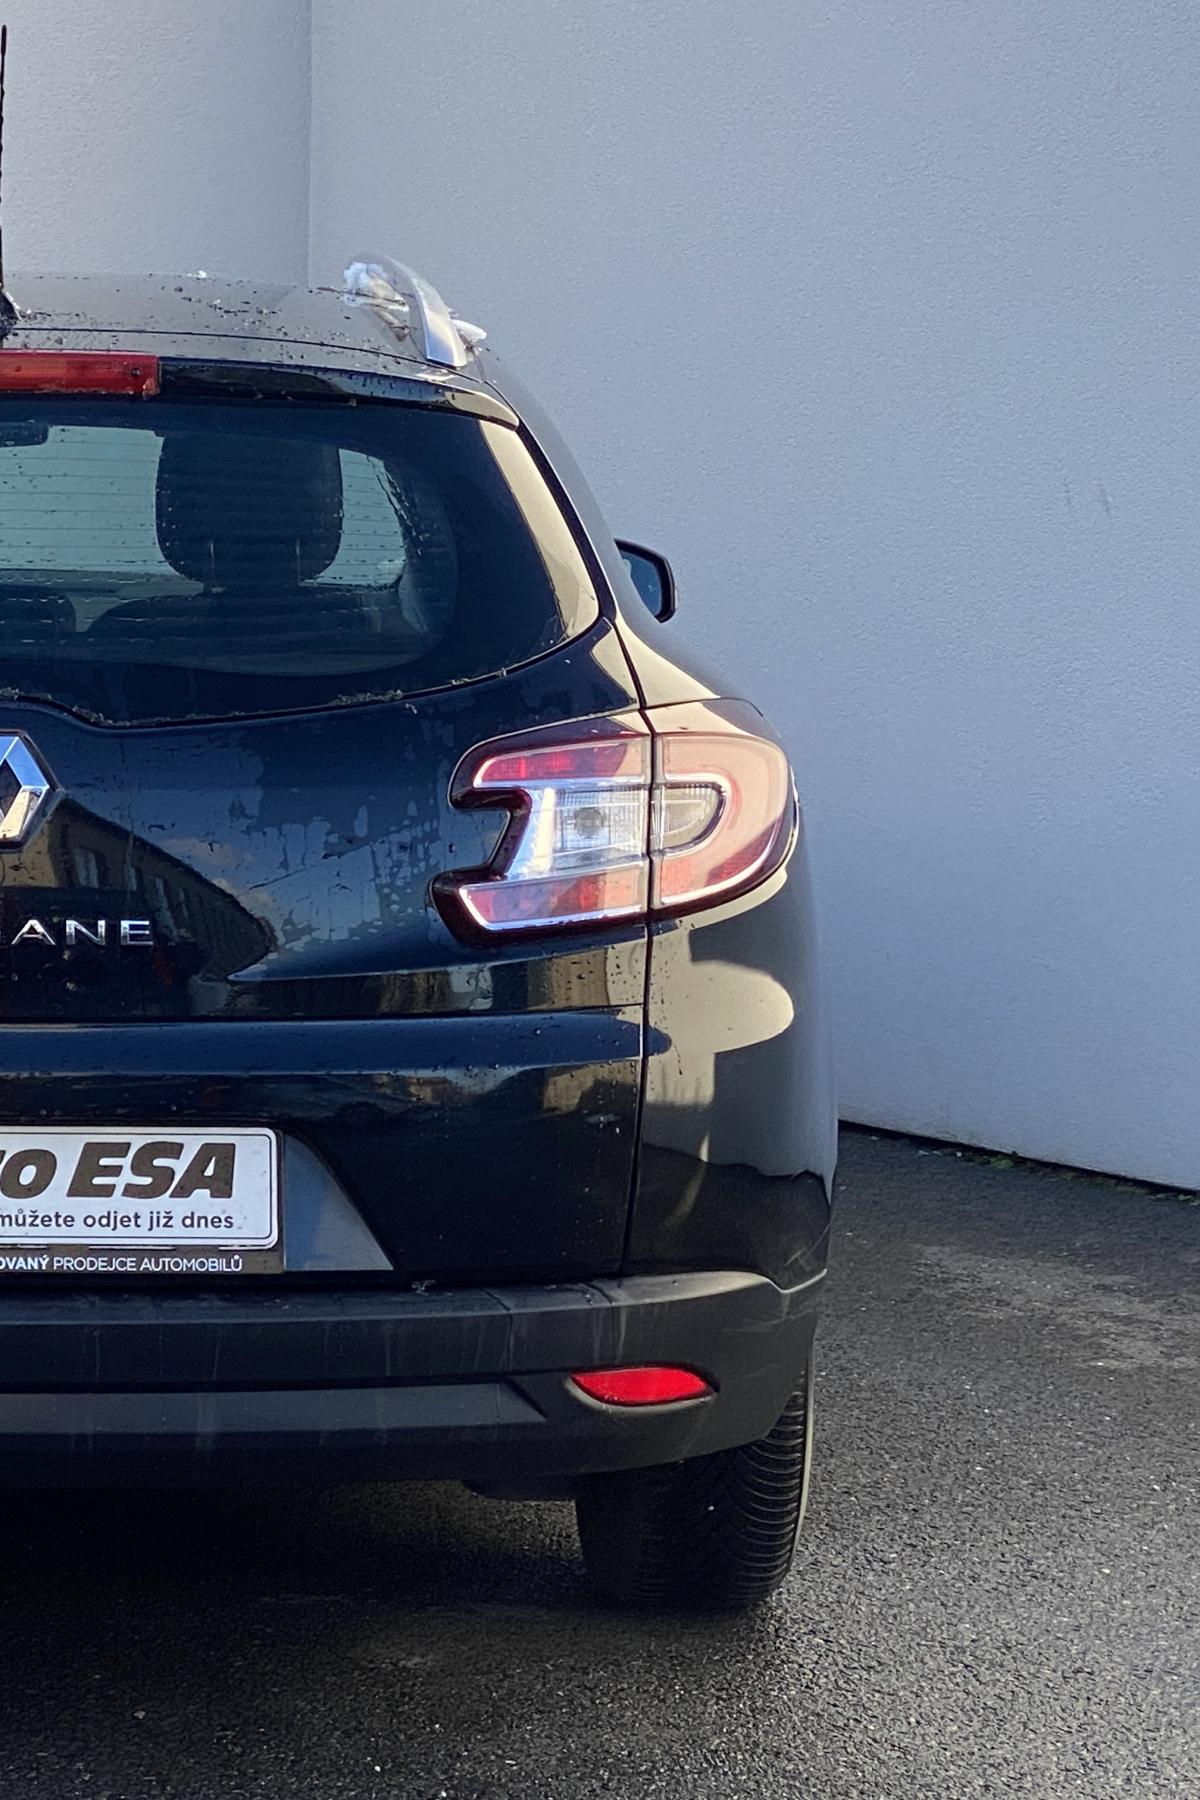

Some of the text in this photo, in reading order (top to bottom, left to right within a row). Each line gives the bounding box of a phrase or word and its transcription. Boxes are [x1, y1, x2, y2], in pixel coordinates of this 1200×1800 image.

[66, 1141, 237, 1199] ESA
[83, 1211, 141, 1231] odjet
[148, 1210, 174, 1232] již
[181, 1211, 234, 1229] dnes
[53, 1257, 137, 1272] PRODEJCE
[139, 1255, 243, 1272] AUTOMOBILŮ
